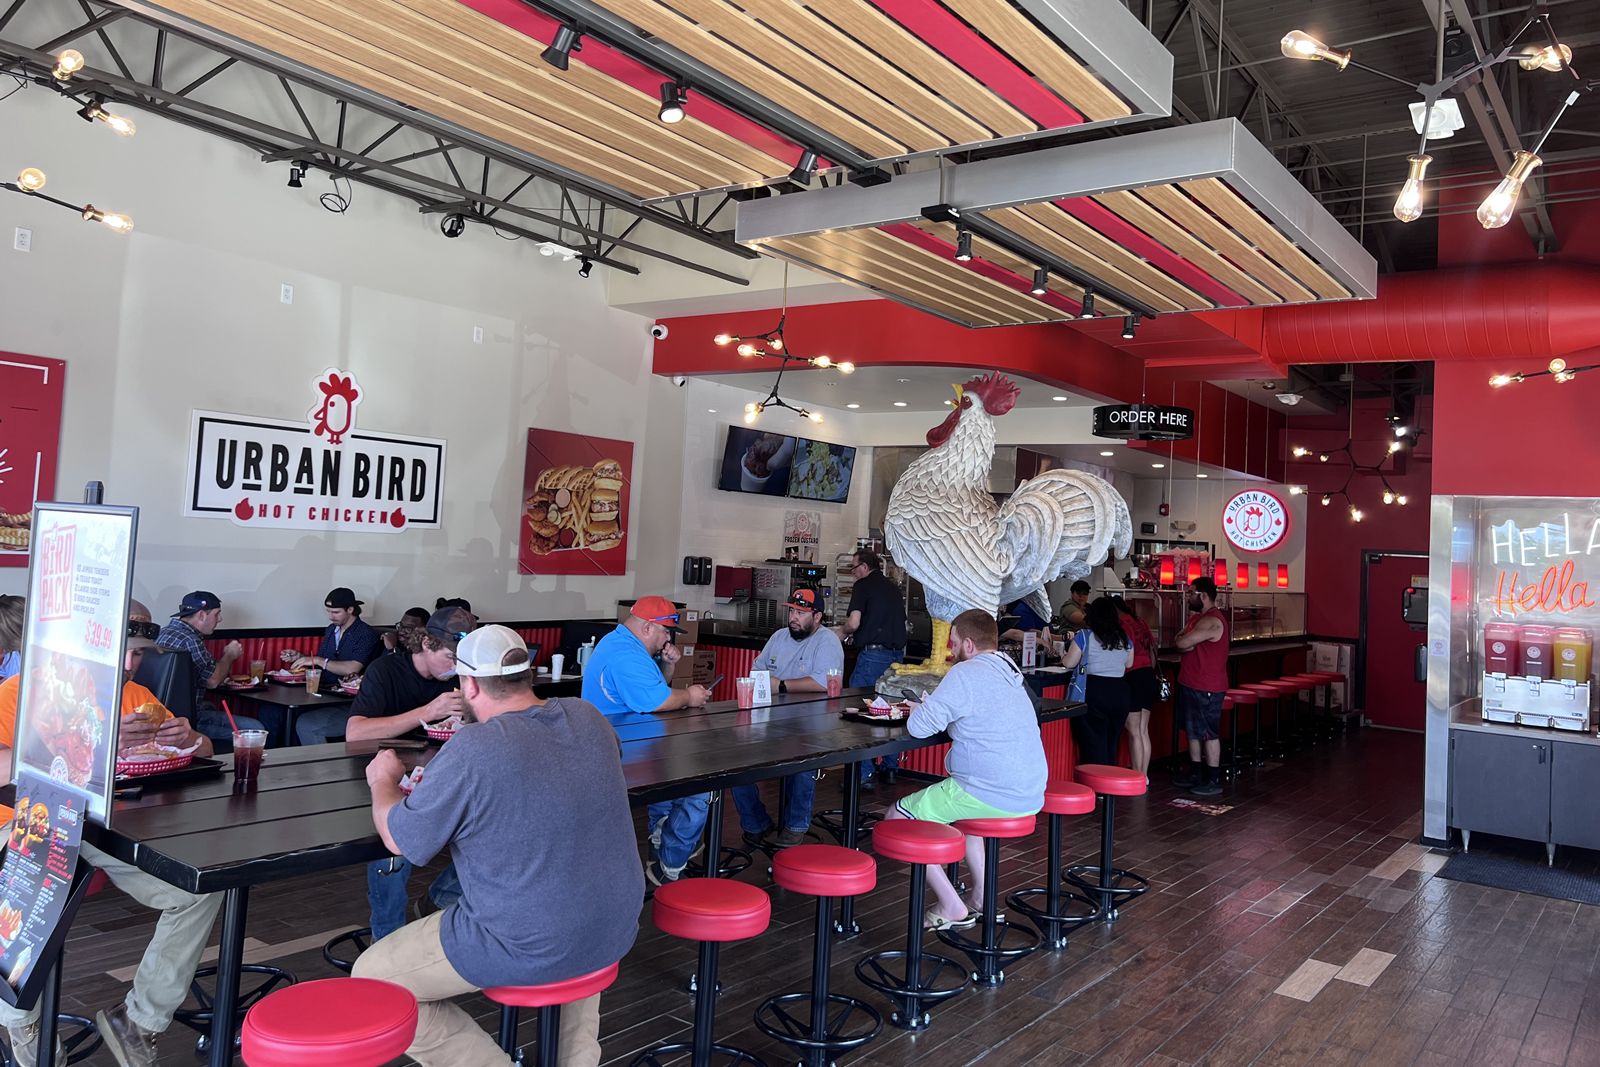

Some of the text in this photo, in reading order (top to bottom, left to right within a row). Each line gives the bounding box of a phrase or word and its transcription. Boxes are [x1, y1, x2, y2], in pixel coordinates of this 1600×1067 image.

[1109, 411, 1156, 424] ORDER
[1159, 411, 1188, 427] HERE
[215, 438, 427, 503] URBAN BIRD
[258, 503, 388, 524] HOT CHICKEN
[1228, 493, 1280, 514] URBAN BIRD
[1231, 530, 1278, 547] HOT CHICKEN
[41, 575, 70, 616] PACK
[1487, 559, 1595, 618] Hella
[85, 618, 113, 649] $39.99
